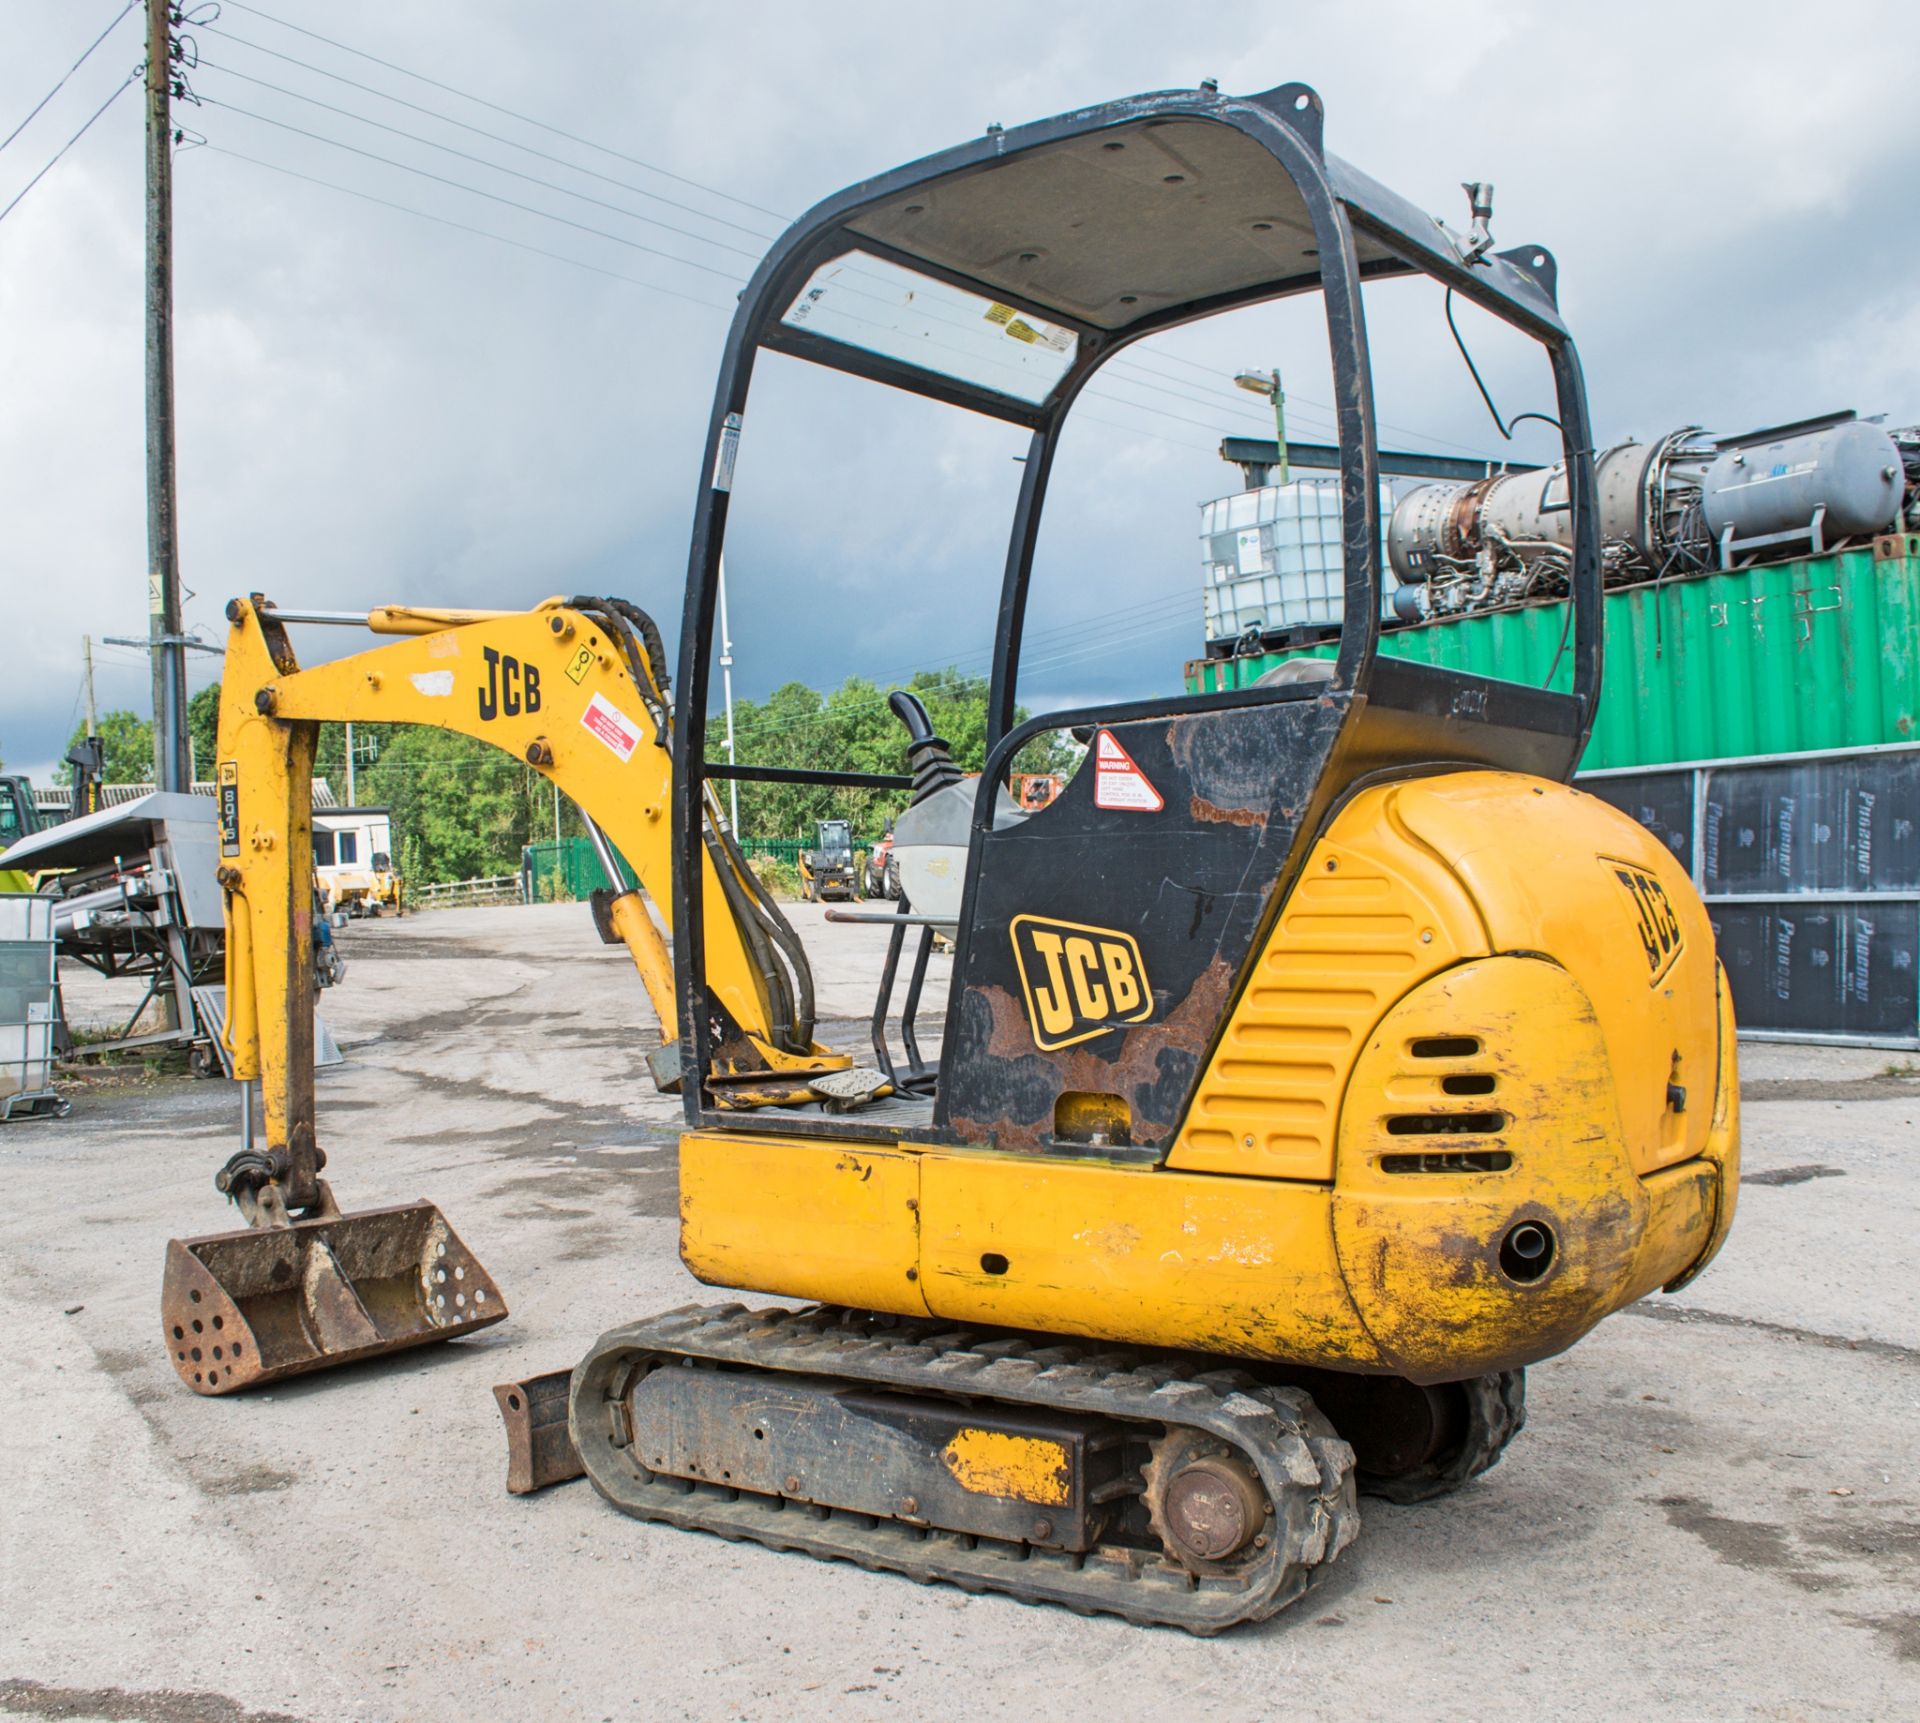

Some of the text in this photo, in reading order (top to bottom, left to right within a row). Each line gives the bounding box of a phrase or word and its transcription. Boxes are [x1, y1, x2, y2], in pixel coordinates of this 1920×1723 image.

[478, 645, 541, 721] JCB
[1099, 761, 1130, 770] WARNING
[1613, 869, 1680, 973] JCB
[1032, 930, 1140, 1035] JCB
